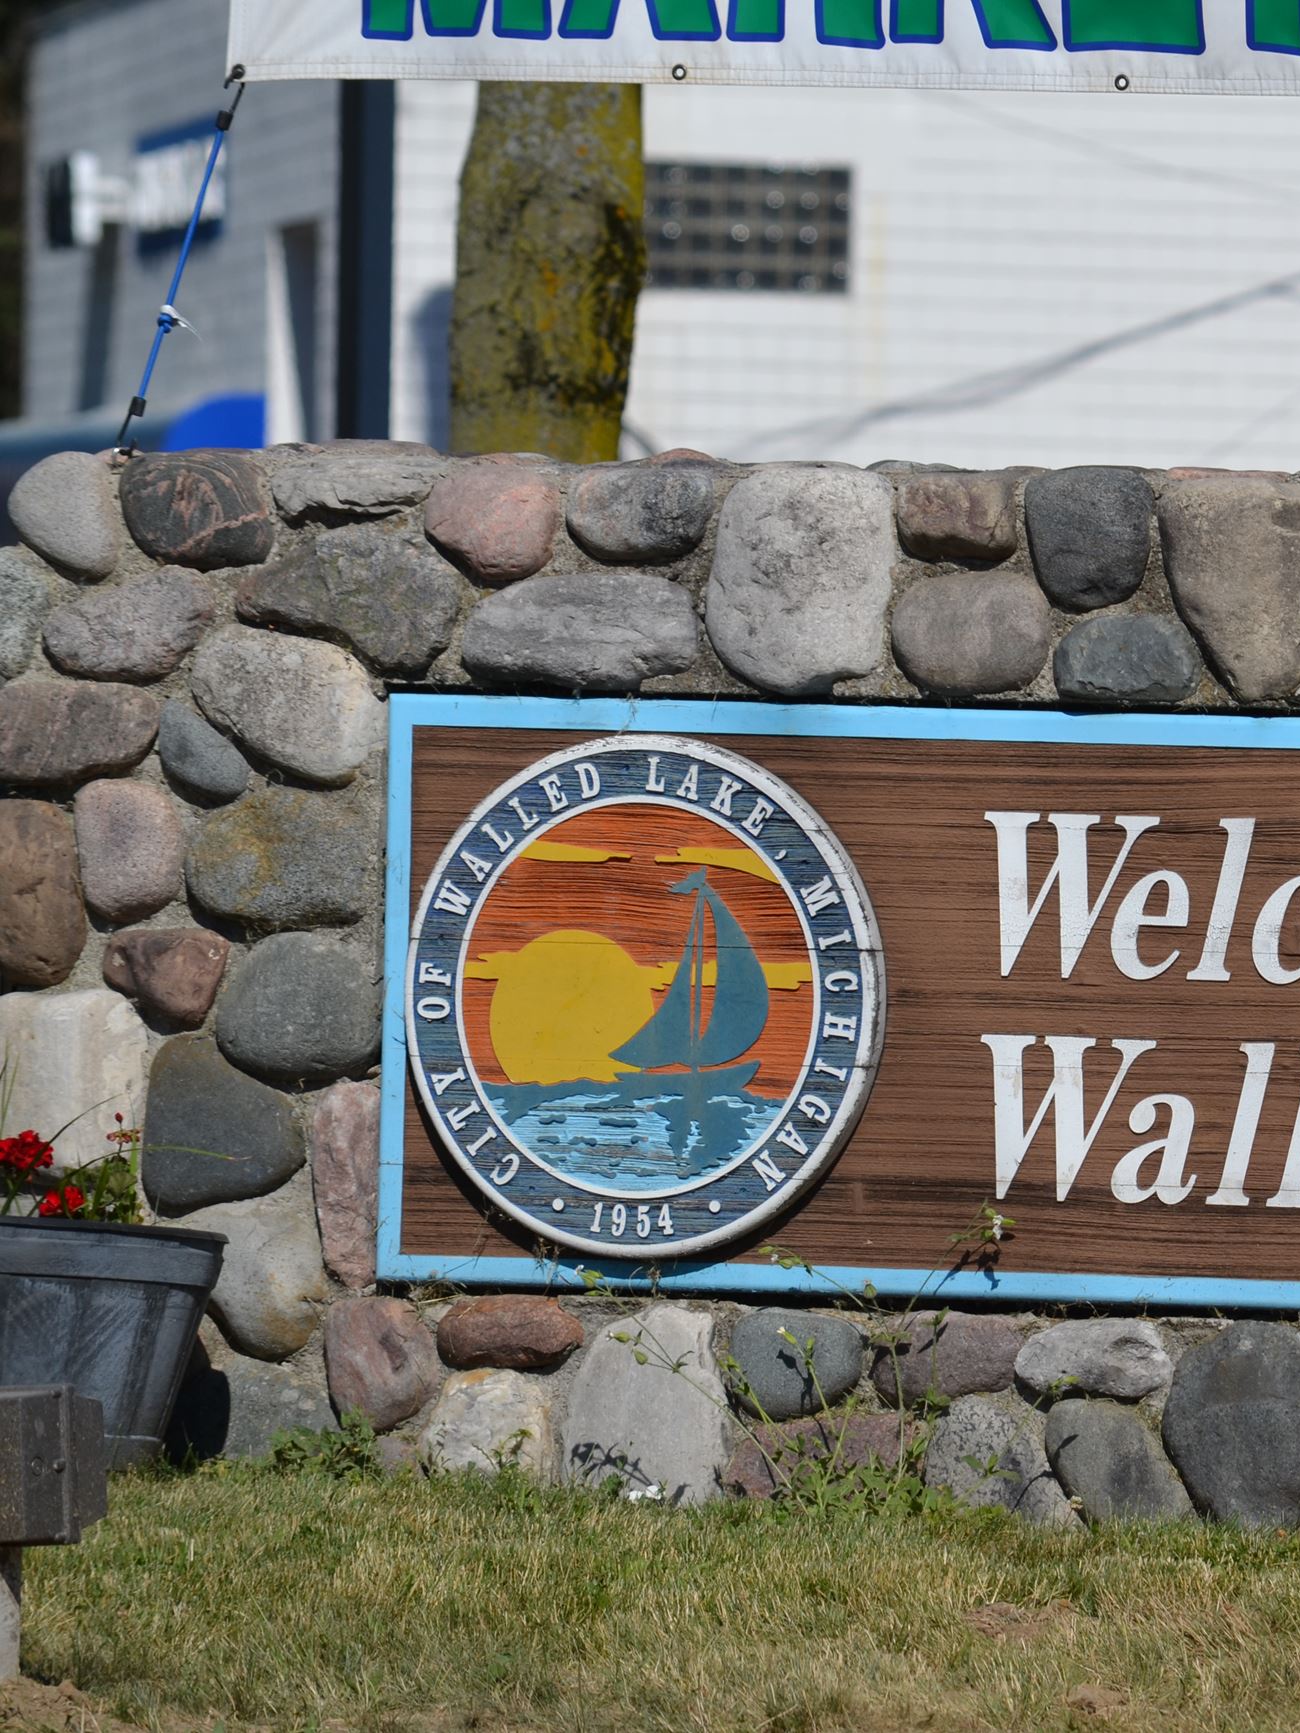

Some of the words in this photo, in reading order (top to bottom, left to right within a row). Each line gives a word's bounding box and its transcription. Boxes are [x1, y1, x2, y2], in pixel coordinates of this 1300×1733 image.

[433, 762, 602, 917] WALLED
[644, 755, 789, 861] LAKE,
[416, 961, 453, 1021] OF
[751, 874, 860, 1193] MICHIGAN
[430, 1066, 521, 1187] CITY
[590, 1201, 675, 1239] 1954
